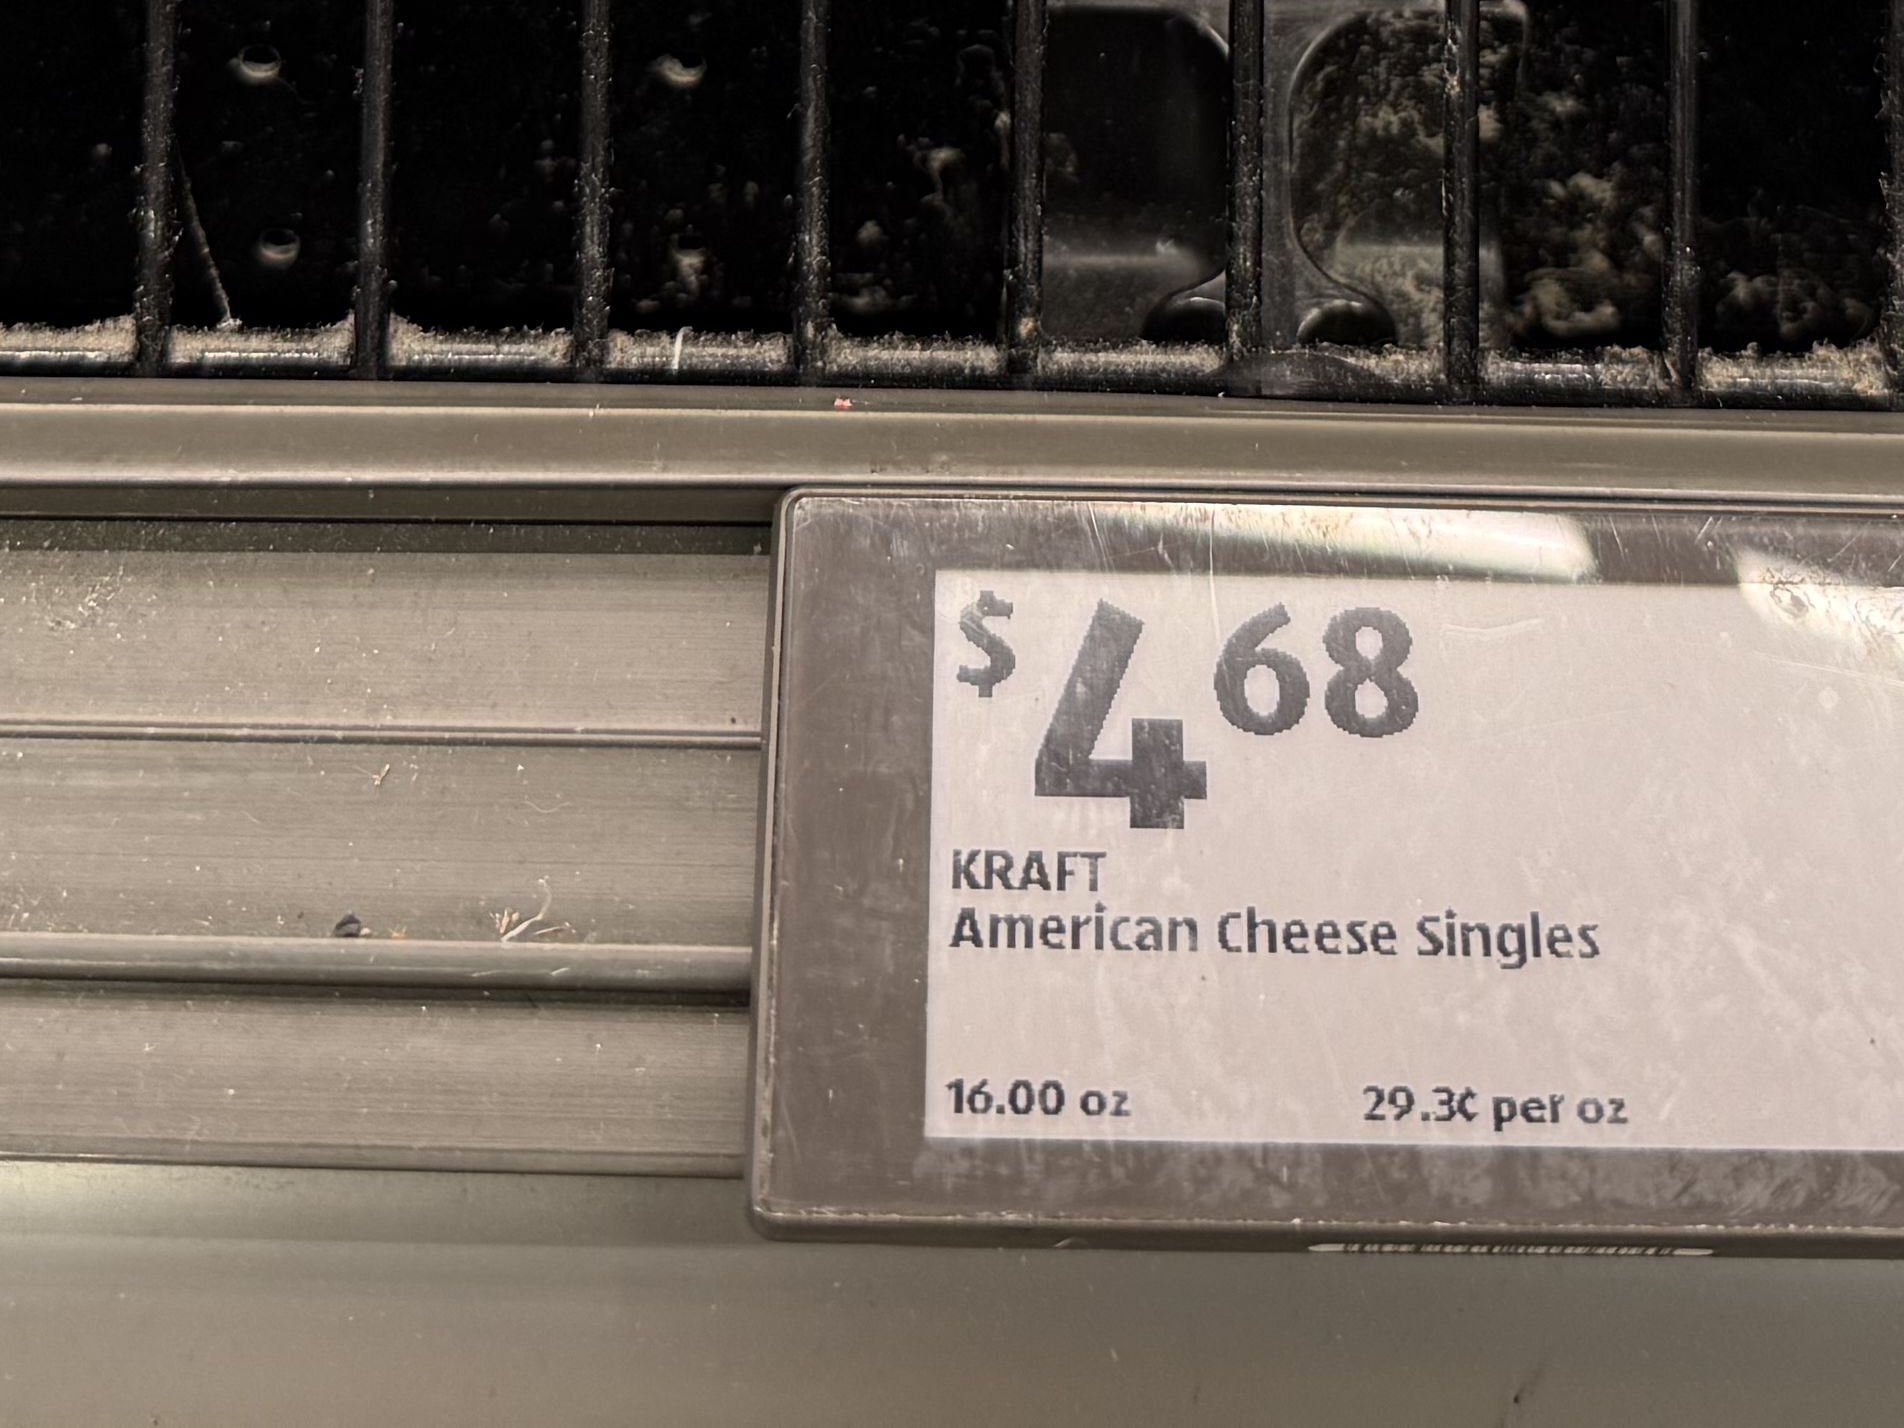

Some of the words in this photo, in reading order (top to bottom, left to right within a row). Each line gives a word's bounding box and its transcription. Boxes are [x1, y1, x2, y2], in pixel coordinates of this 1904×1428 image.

[952, 850, 1106, 894] KRAFT
[950, 905, 1198, 956] American
[1216, 908, 1398, 960] Cheese
[1415, 908, 1601, 970] Singles
[946, 1080, 1065, 1118] 16.00
[1078, 1092, 1130, 1119] oz
[1361, 1083, 1479, 1125] 29.3¢
[1492, 1093, 1566, 1133] per
[1578, 1096, 1629, 1126] oz
